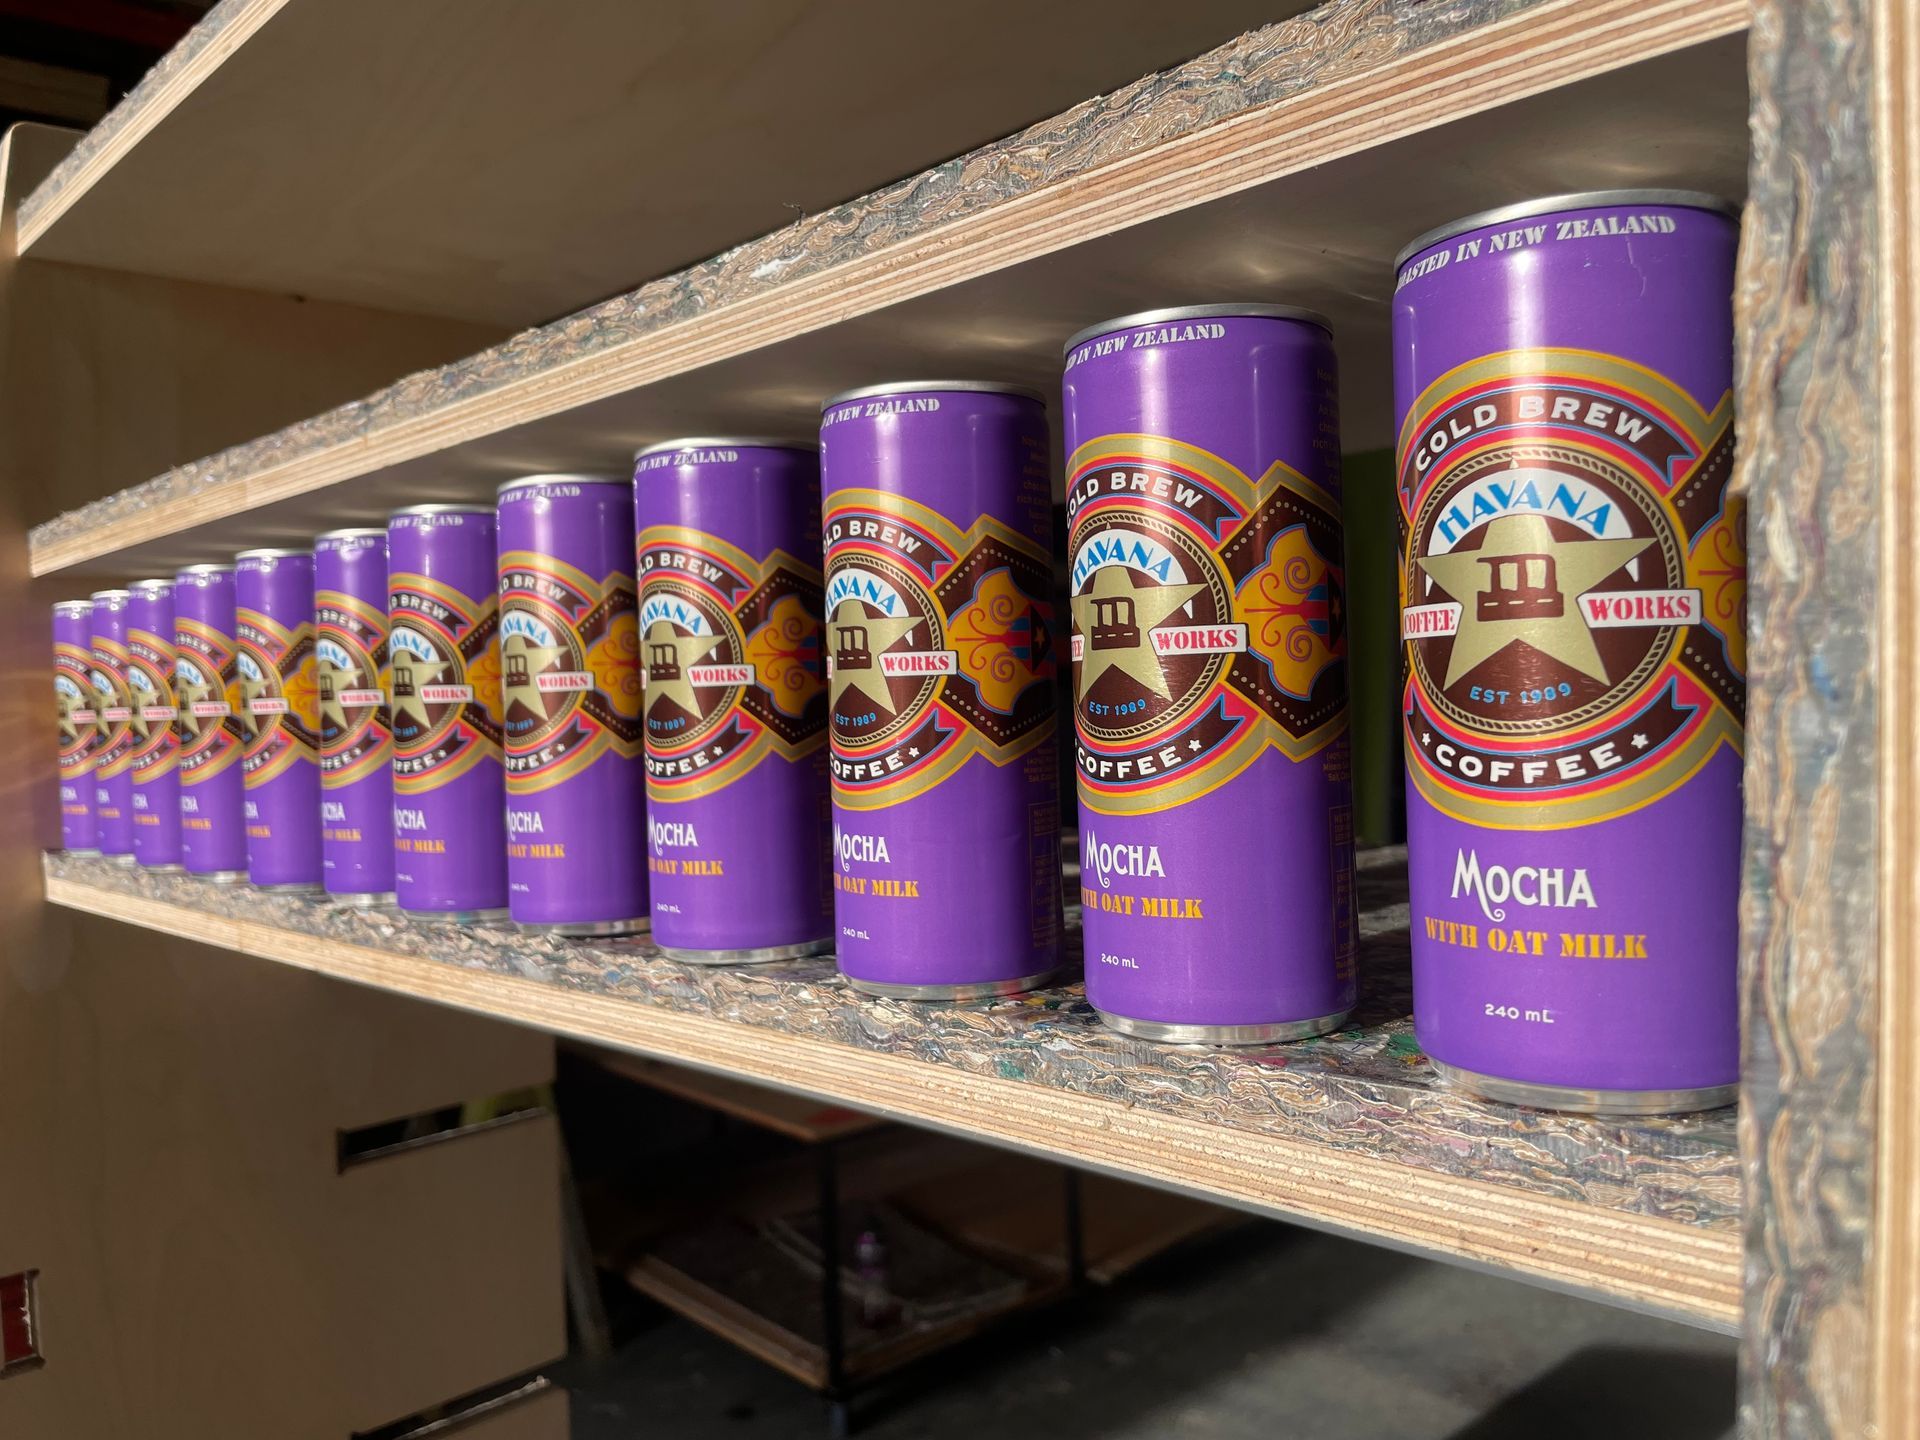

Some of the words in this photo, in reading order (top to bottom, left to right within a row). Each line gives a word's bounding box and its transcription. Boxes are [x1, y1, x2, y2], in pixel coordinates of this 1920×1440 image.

[1455, 239, 1482, 263] IN
[1488, 223, 1548, 253] NEW
[1556, 215, 1676, 240] ZEALAND
[1076, 346, 1091, 365] IN
[1092, 335, 1129, 358] NEW
[1132, 323, 1226, 349] ZEALAND
[836, 405, 863, 423] NEW
[865, 398, 940, 418] ZEALAND
[1415, 404, 1498, 472] COLD
[1519, 396, 1652, 444] BREW
[648, 455, 672, 471] NEW
[674, 450, 738, 466] ZEALAND
[1111, 472, 1203, 508] BREW
[1437, 479, 1611, 544] HAVANA
[823, 524, 842, 555] LD
[849, 520, 922, 554] BREW
[660, 552, 723, 583] BREW
[1073, 537, 1173, 588] HAVANA
[514, 574, 567, 600] BREW
[1404, 608, 1455, 634] COFFEE
[1587, 595, 1691, 621] WORKS
[1156, 629, 1238, 650] WORKS
[690, 668, 749, 682] WORKS
[883, 655, 950, 671] WORKS
[539, 676, 588, 688] WORKS
[1470, 686, 1510, 704] EST
[1520, 682, 1572, 704] 1989
[835, 713, 849, 726] EST
[852, 712, 877, 726] 1989
[1089, 702, 1110, 716] EST
[1115, 698, 1147, 716] 1989
[1077, 745, 1182, 779] COFFEE
[1436, 741, 1622, 784] COFFEE
[682, 860, 724, 875] MILK
[1085, 829, 1166, 888] MOCHA
[843, 876, 867, 895] OAT
[872, 879, 920, 898] MILK
[1451, 848, 1598, 922] MOCHA
[1101, 893, 1135, 915] OAT
[1141, 897, 1203, 919] MILK
[843, 926, 855, 937] 240
[1425, 916, 1478, 948] WITH
[1487, 928, 1548, 955] OAT
[1560, 933, 1648, 959] MILK
[1101, 953, 1119, 966] 240
[1121, 956, 1139, 969] mL
[1485, 1004, 1520, 1019] 240
[1525, 1009, 1554, 1023] mL
